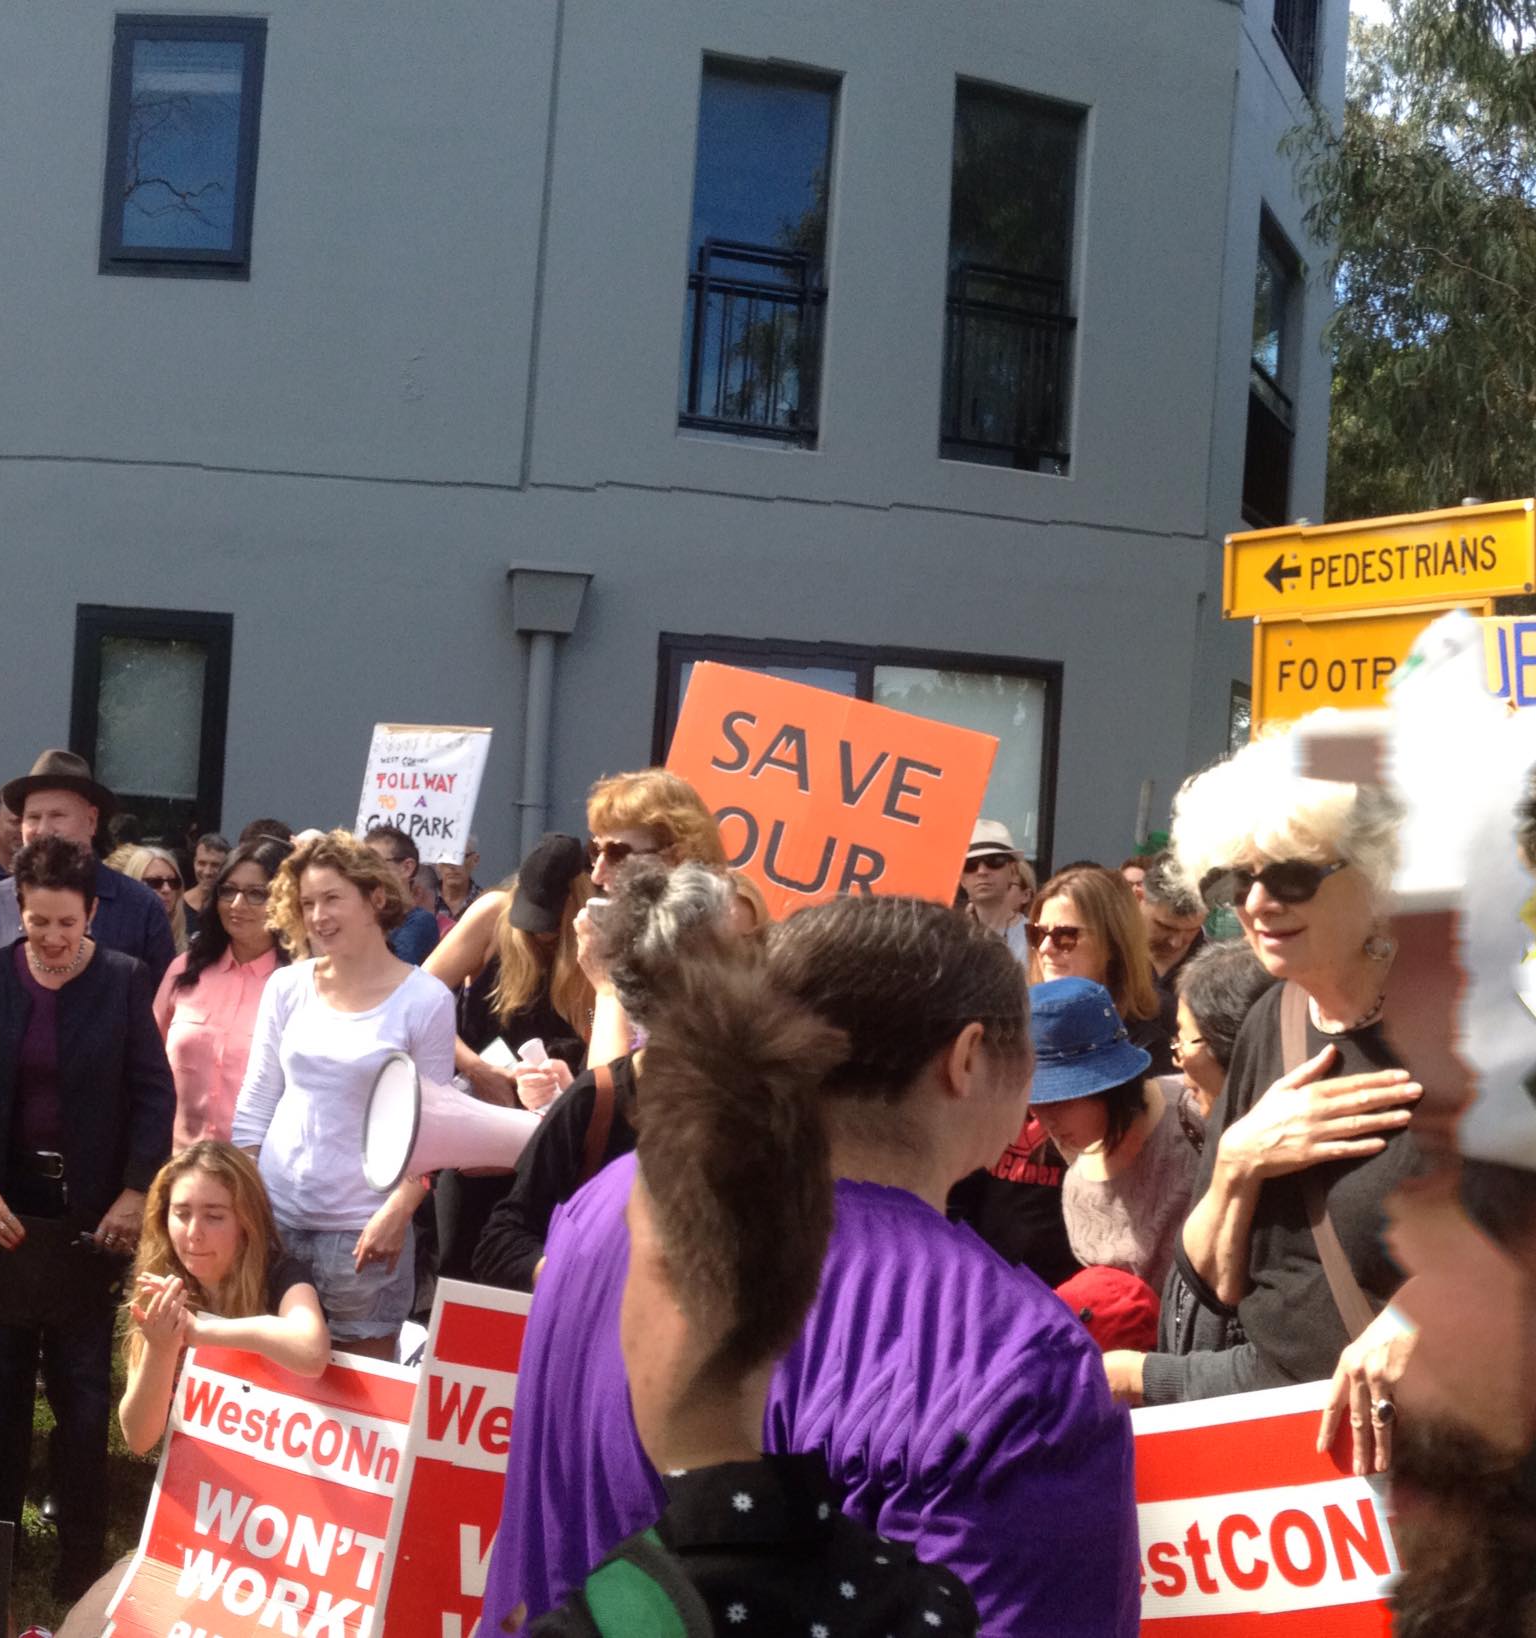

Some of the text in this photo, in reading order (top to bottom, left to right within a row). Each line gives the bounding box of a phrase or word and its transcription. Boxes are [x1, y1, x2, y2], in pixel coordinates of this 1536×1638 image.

[1310, 535, 1497, 590] PEDESTRIANS
[1278, 656, 1396, 693] FOOTP
[377, 795, 427, 811] TO A
[711, 711, 944, 828] SAVE
[713, 806, 886, 898] OUR
[182, 1376, 401, 1485] WestCONn
[193, 1480, 386, 1593] WON'T
